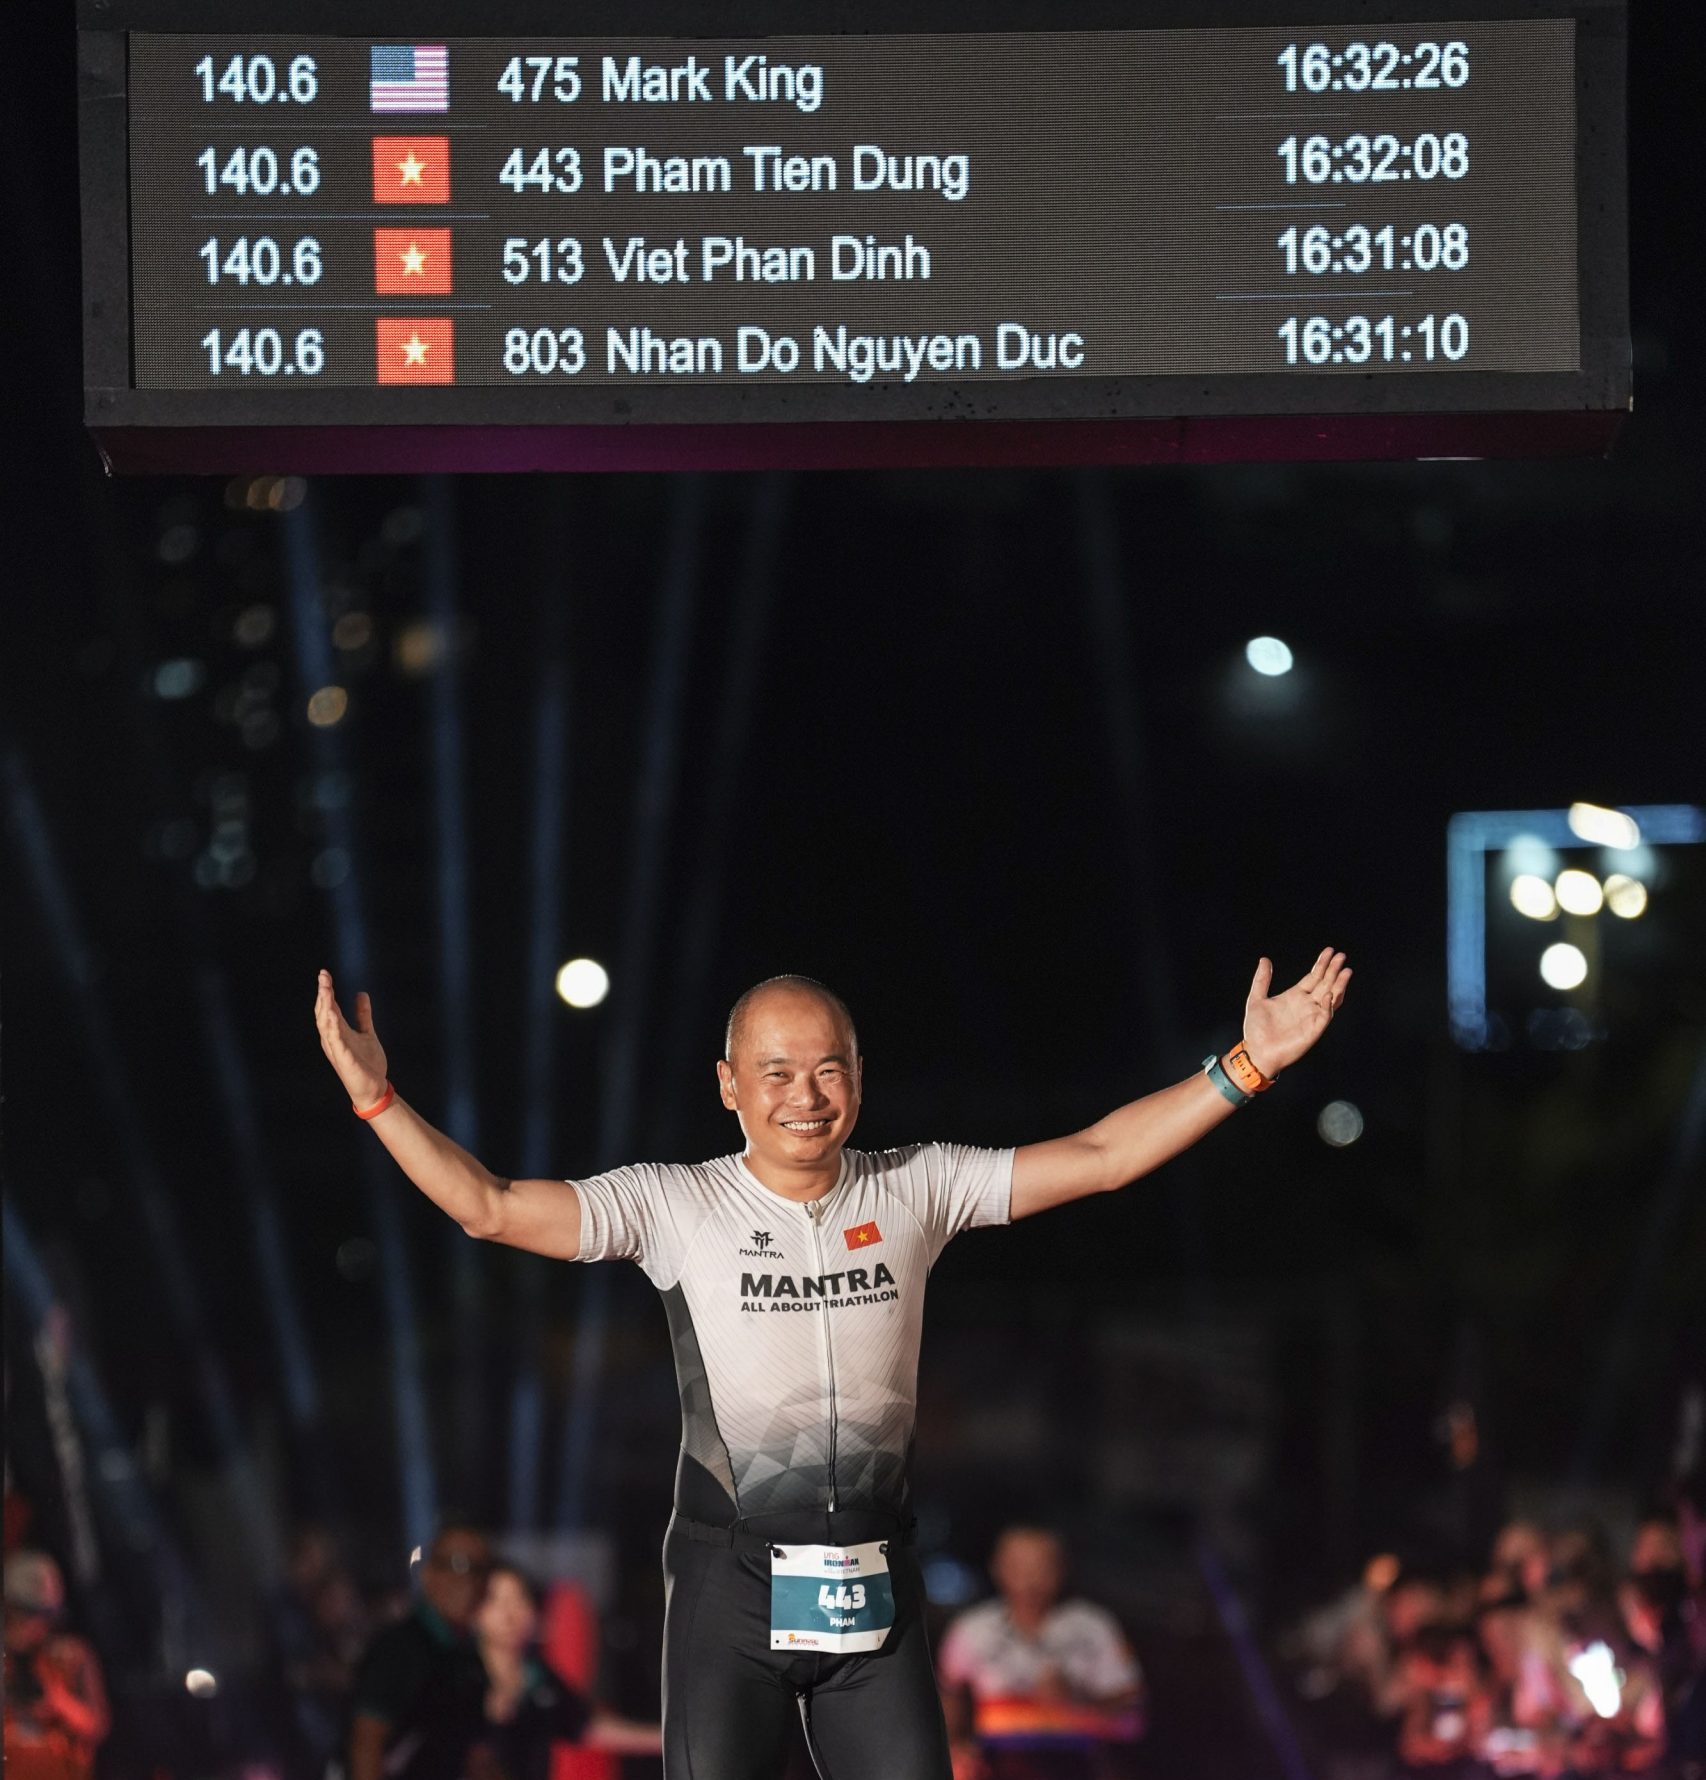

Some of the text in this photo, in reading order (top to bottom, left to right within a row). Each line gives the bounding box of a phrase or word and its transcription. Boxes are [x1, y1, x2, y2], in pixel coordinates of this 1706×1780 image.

[195, 41, 1469, 113] 140.6 475 Mark King 16:32:26
[198, 132, 1469, 201] 140.6 443 Pham Tien Dung 16:32:08
[200, 223, 1469, 285] 140.6 513 Viet Phan Dinh 16:31:08
[202, 313, 1469, 383] 140.6 803 Nhan Do Nguyen Duc 16:31:10
[739, 1248, 785, 1260] MANTRA
[740, 1262, 896, 1299] MANTRA
[741, 1288, 899, 1313] ALL ABOUT TRIATHLON
[818, 1584, 866, 1610] 443
[829, 1617, 856, 1628] PHAM
